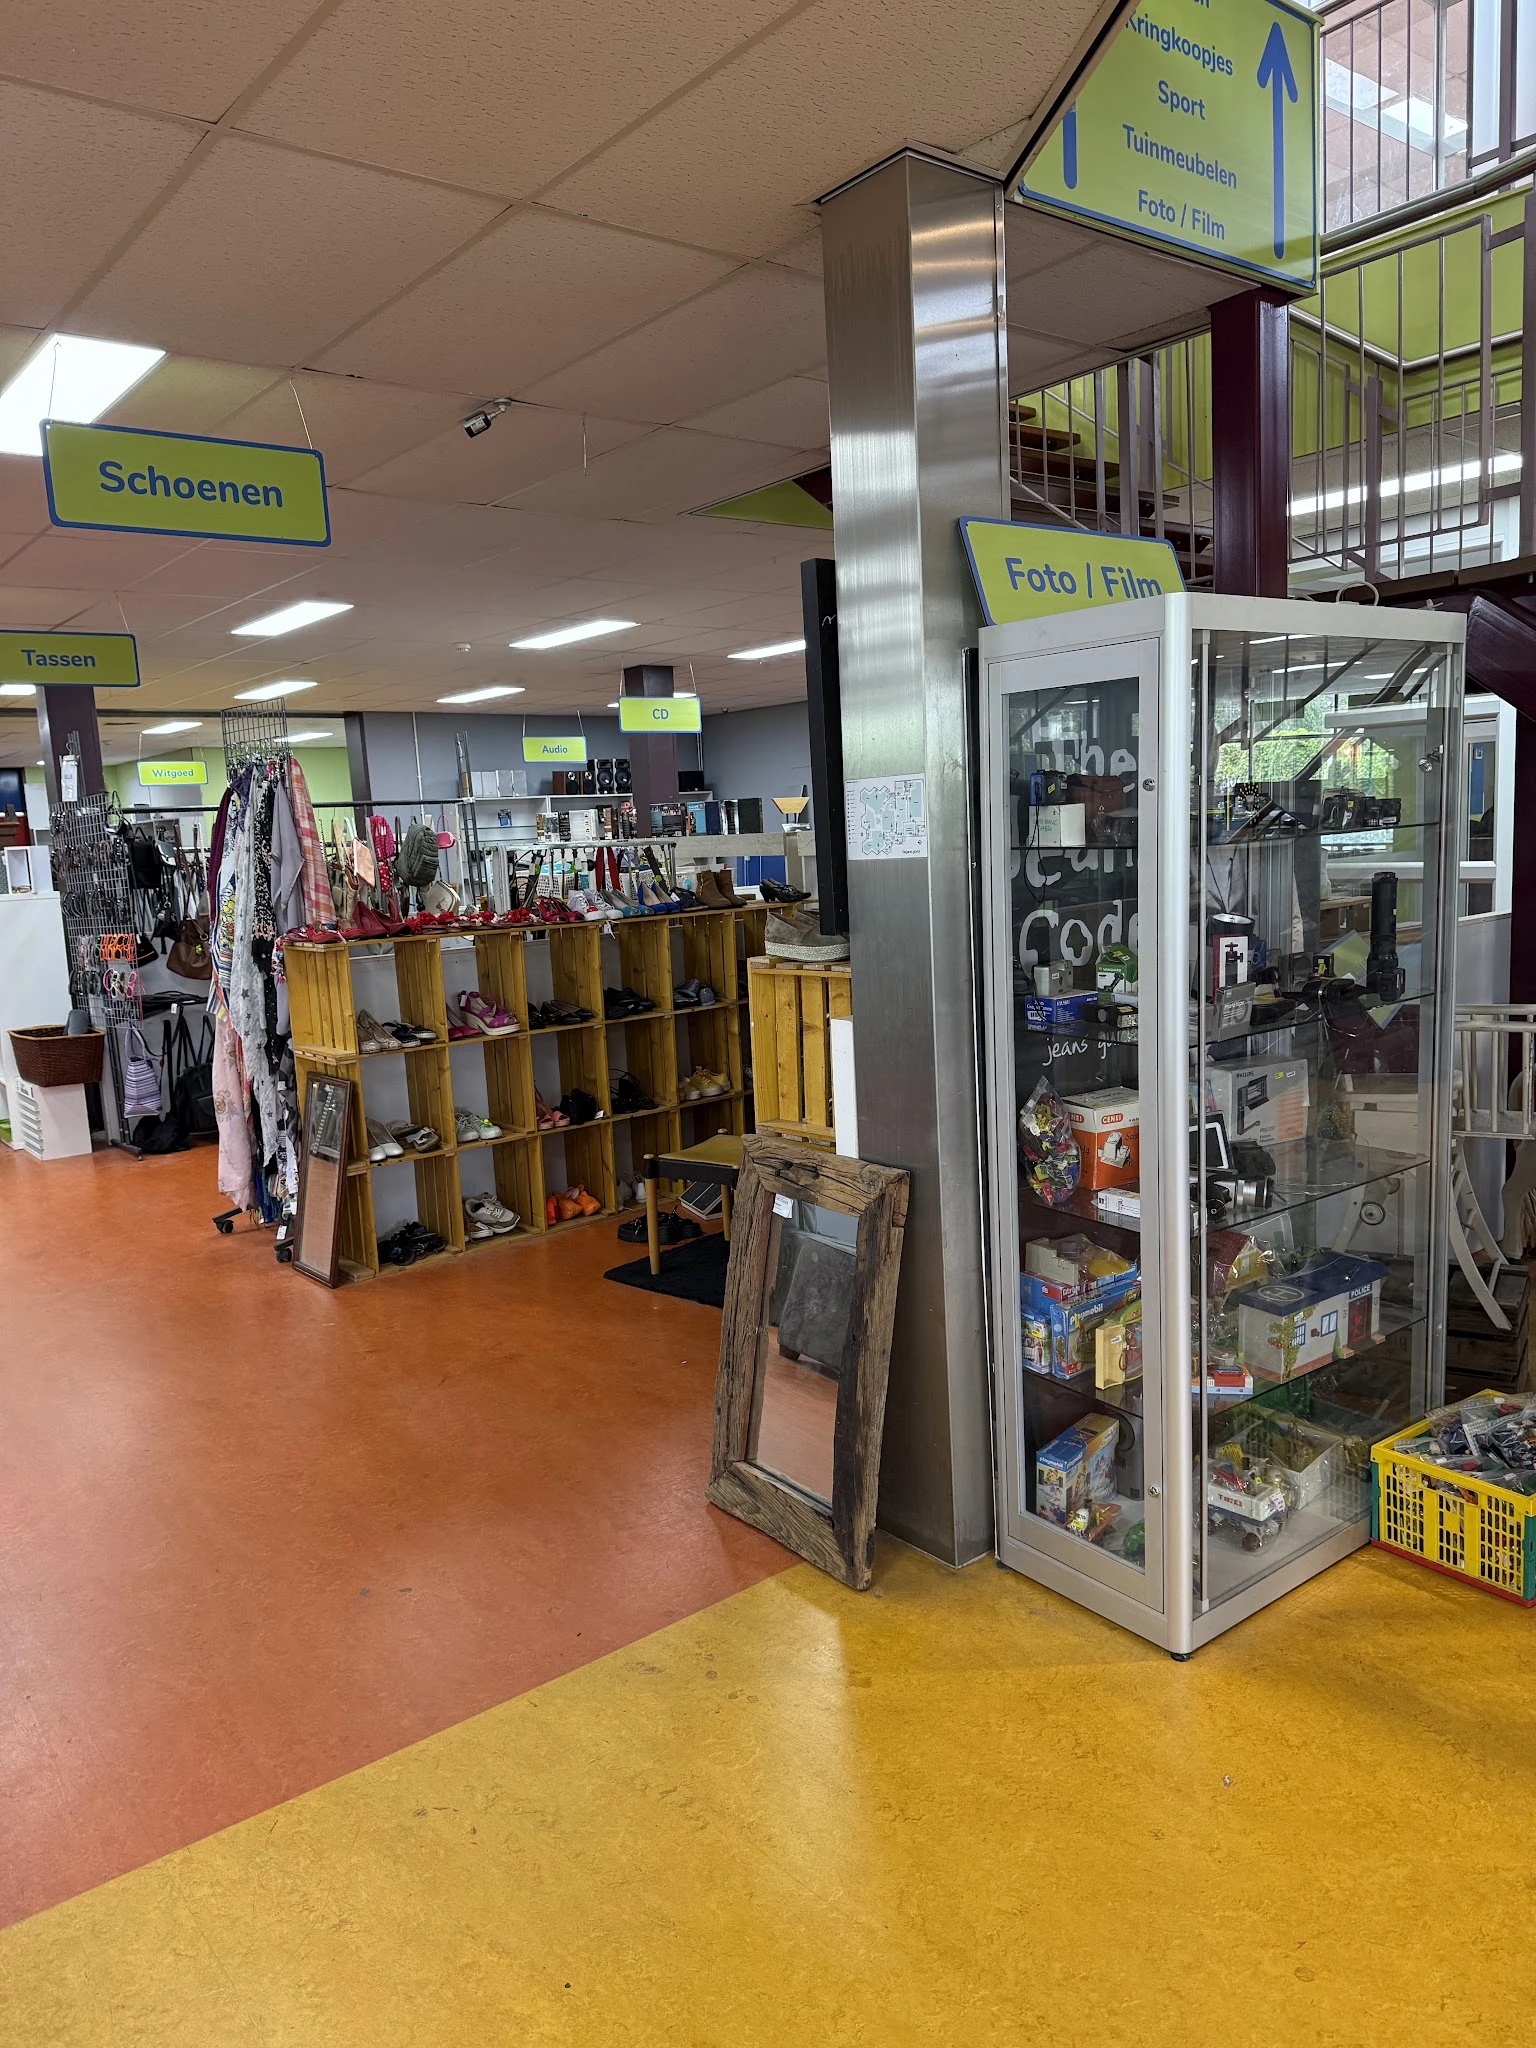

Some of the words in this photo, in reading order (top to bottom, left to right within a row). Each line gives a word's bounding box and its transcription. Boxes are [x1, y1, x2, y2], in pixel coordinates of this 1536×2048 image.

[1125, 9, 1233, 76] Kringkoopjes
[1158, 80, 1205, 120] Sport
[1123, 124, 1237, 189] Tuinmeubelen
[1138, 189, 1176, 223] Foto
[1192, 208, 1225, 240] Film
[99, 461, 282, 508] Schoenen
[1005, 557, 1077, 595] Foto
[1101, 566, 1162, 599] Film
[21, 649, 96, 667] Tassen
[652, 708, 669, 720] CD
[542, 745, 568, 754] Audio
[152, 769, 194, 778] Witgoed
[1351, 1284, 1371, 1298] POLICE
